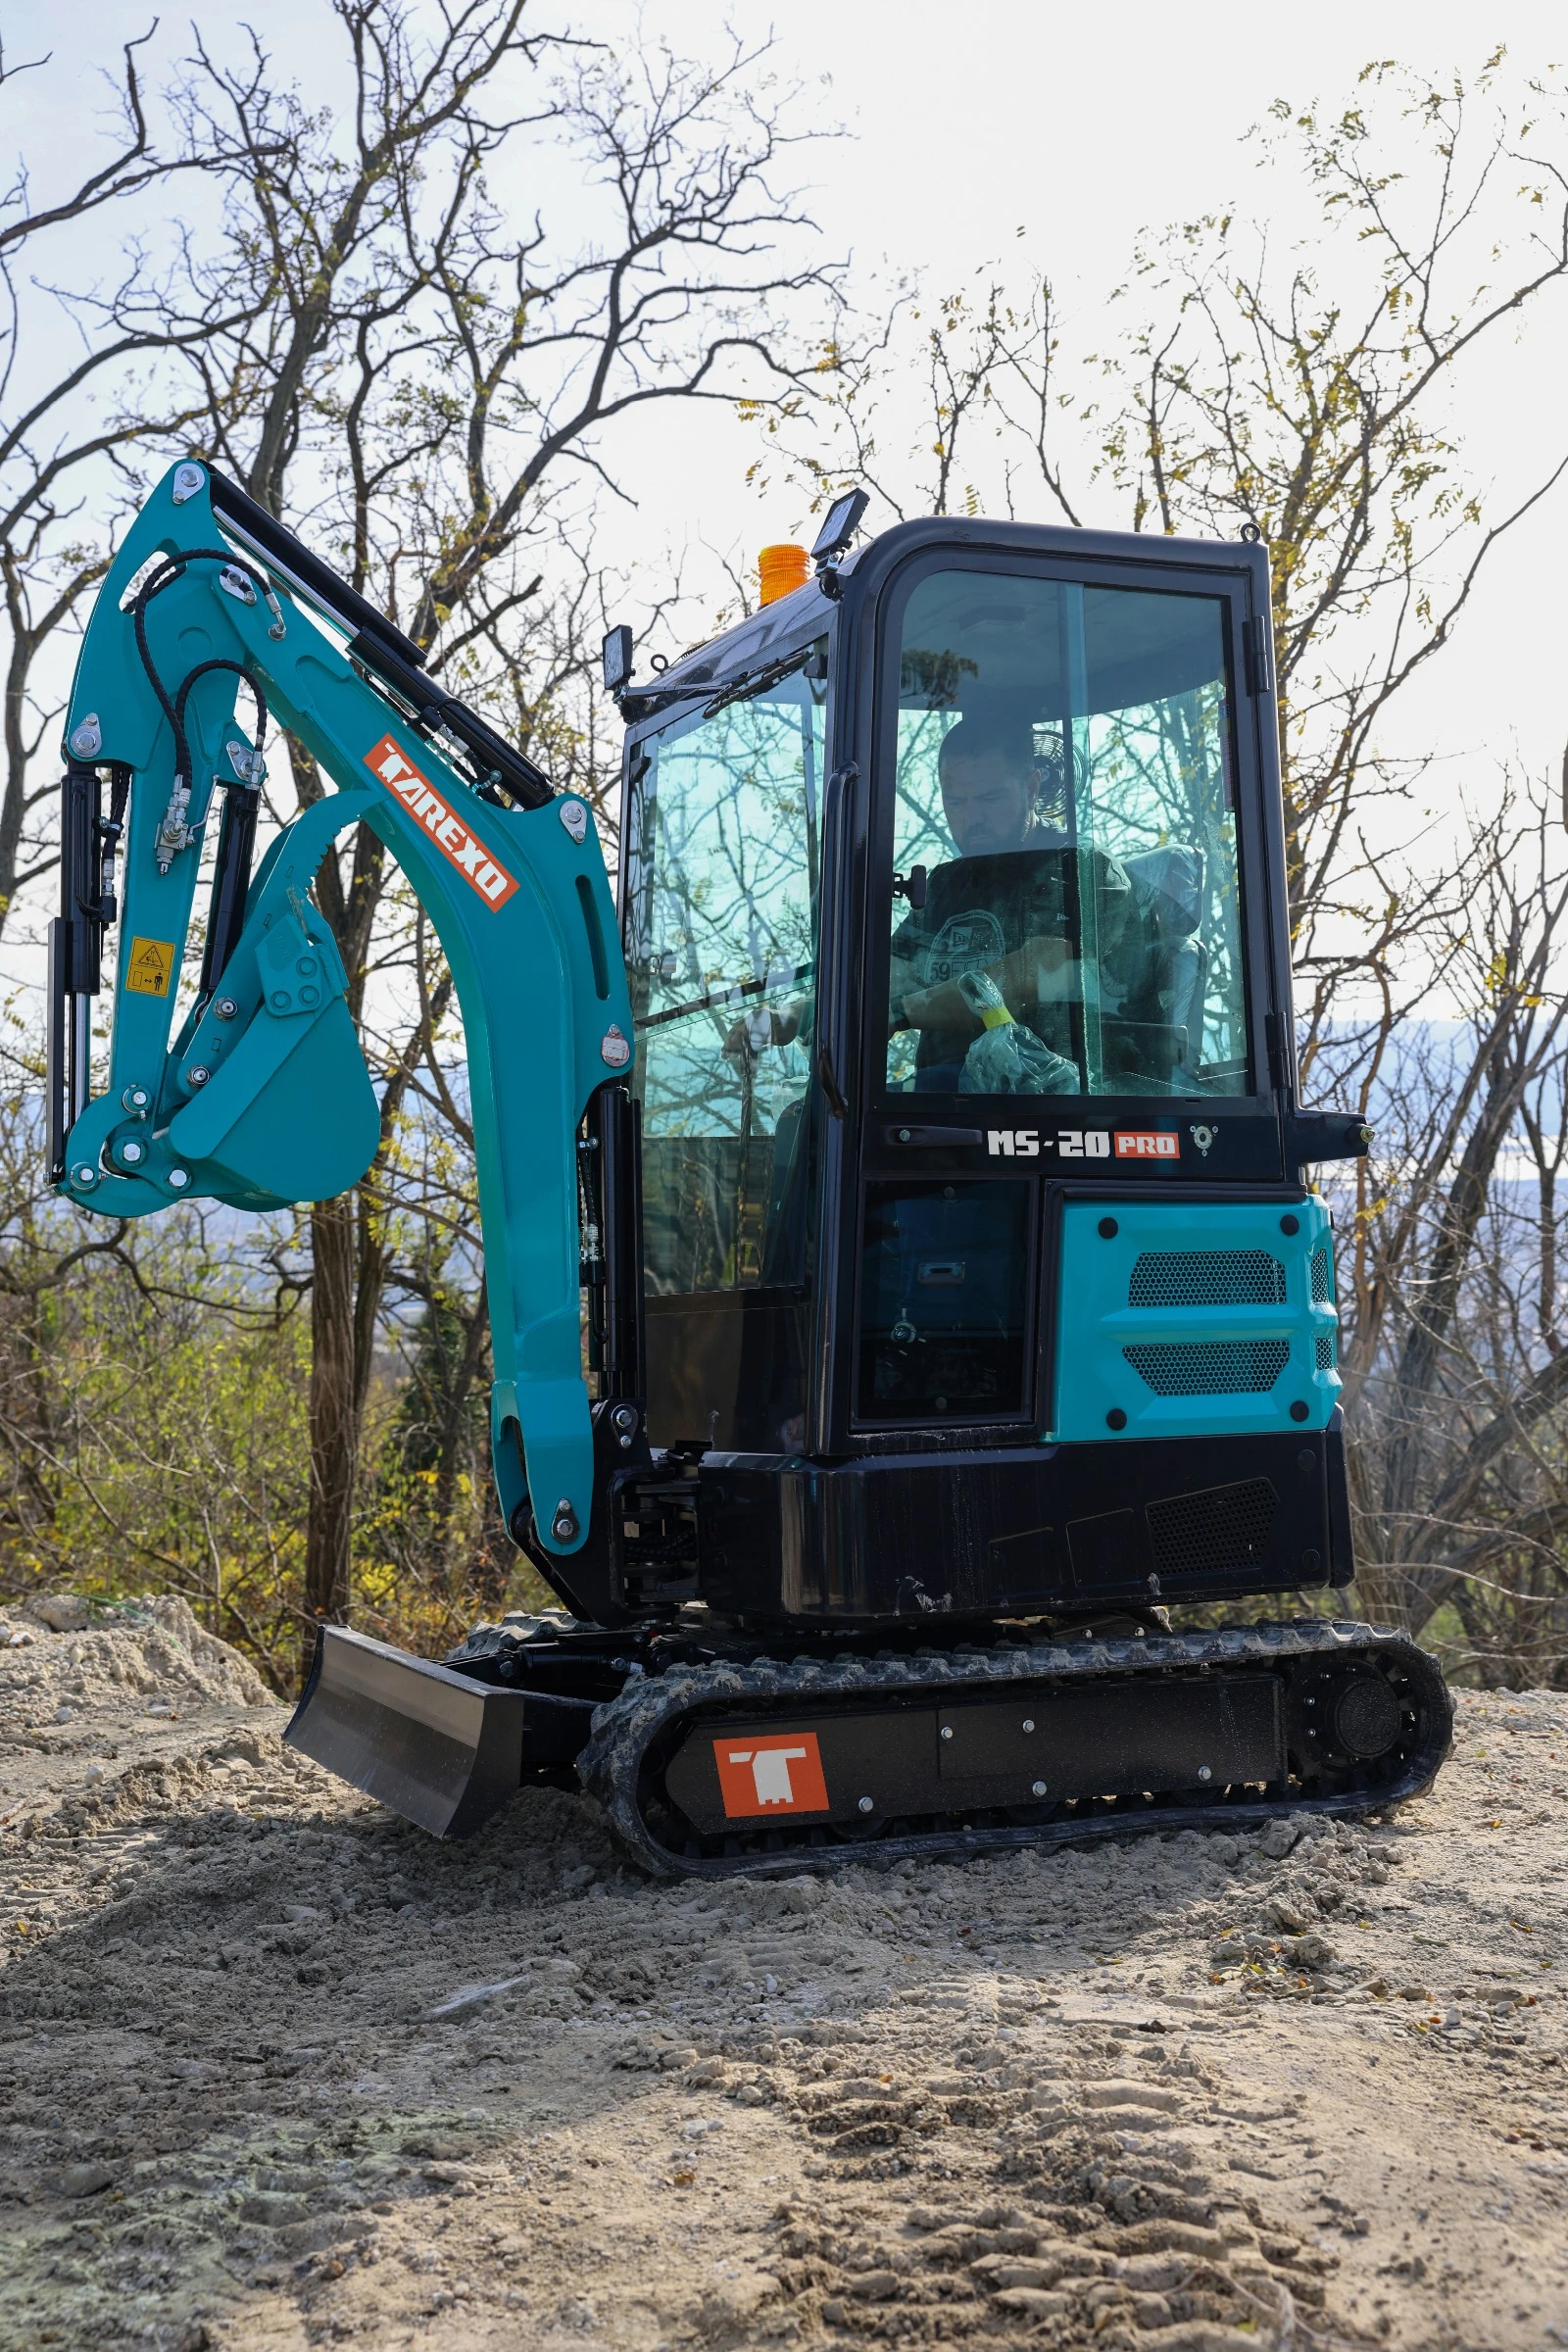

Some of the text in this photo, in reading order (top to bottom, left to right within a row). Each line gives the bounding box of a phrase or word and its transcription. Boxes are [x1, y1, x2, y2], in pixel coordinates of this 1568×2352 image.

[377, 742, 508, 902] TAREXO
[987, 1130, 1176, 1157] MS-20 PRO
